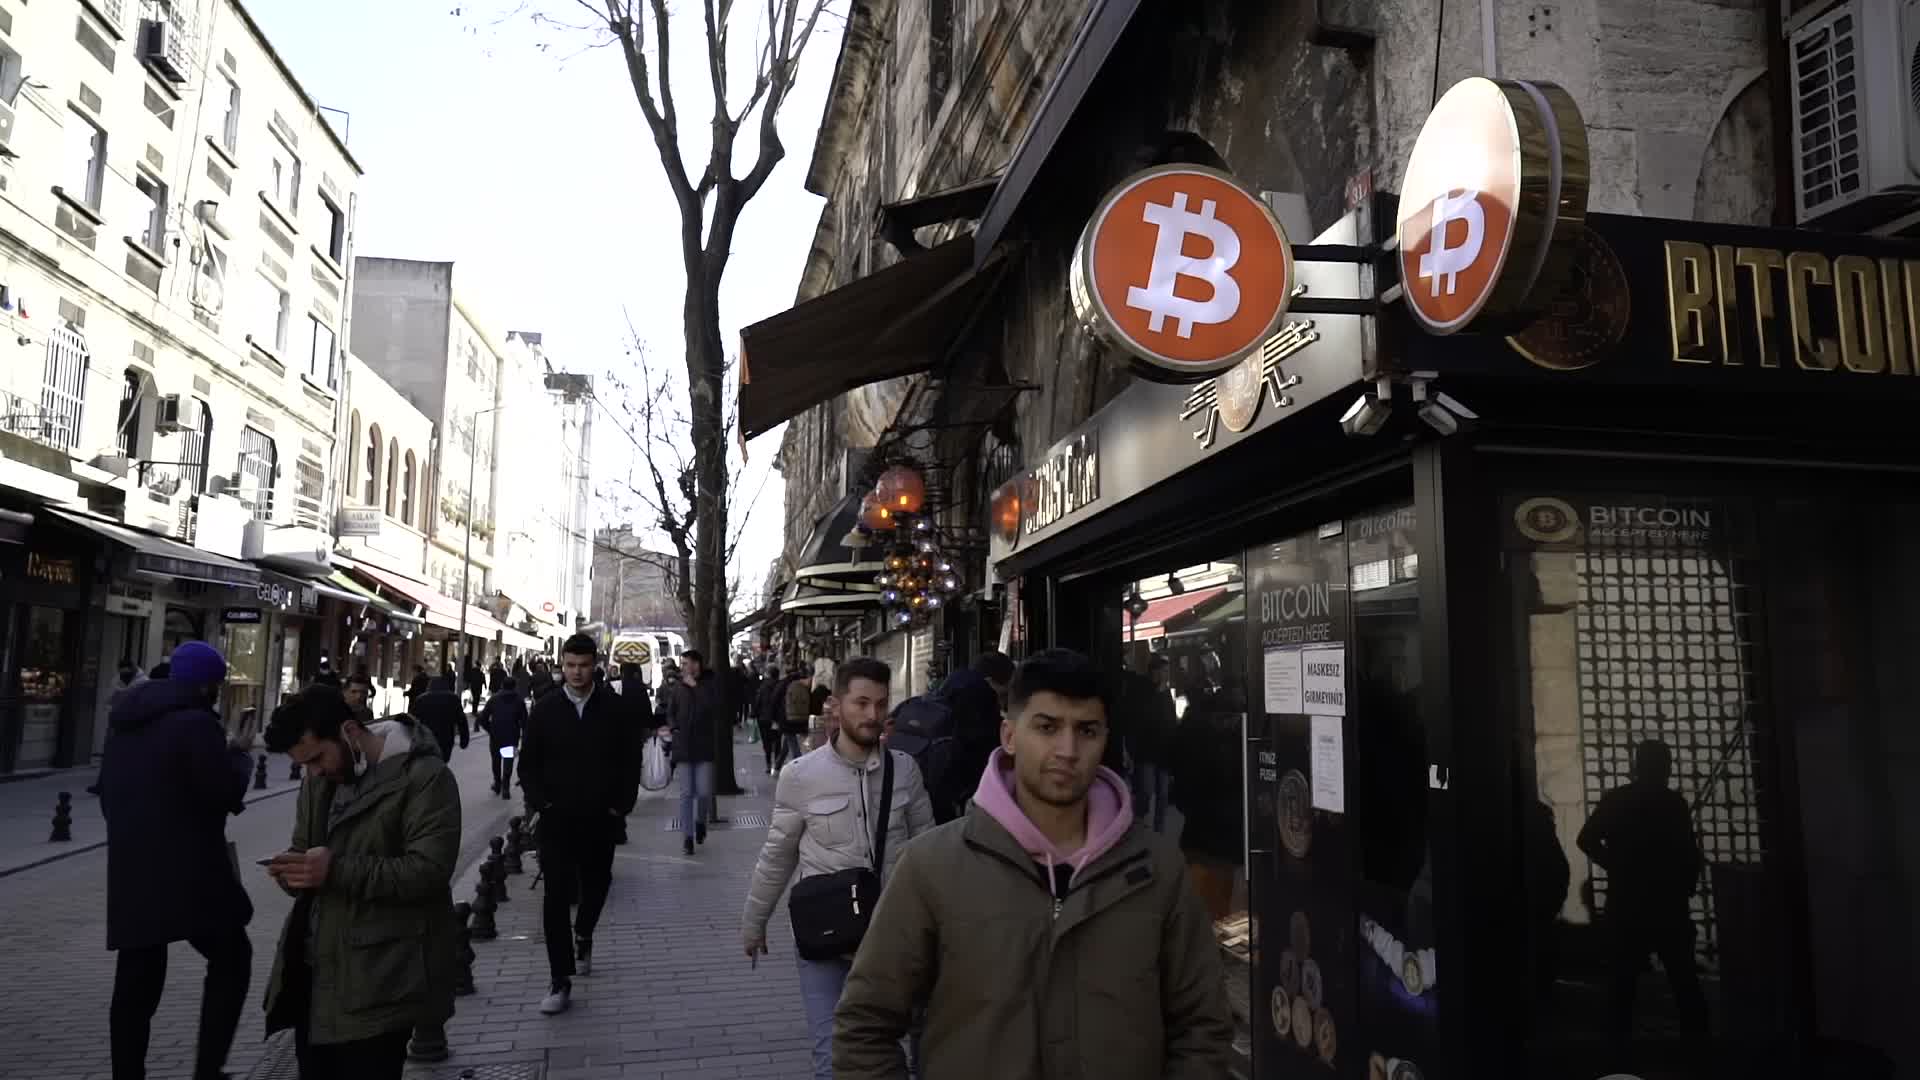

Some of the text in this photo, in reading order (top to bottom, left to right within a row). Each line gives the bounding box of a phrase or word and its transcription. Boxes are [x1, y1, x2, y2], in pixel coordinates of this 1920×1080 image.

[1664, 240, 1920, 374] BITCOI
[1589, 506, 1711, 527] BITCOIN
[1591, 528, 1669, 539] ACCEPTED
[1262, 583, 1330, 624] BITCOIN
[1263, 623, 1331, 644] ACCEPTED HERE
